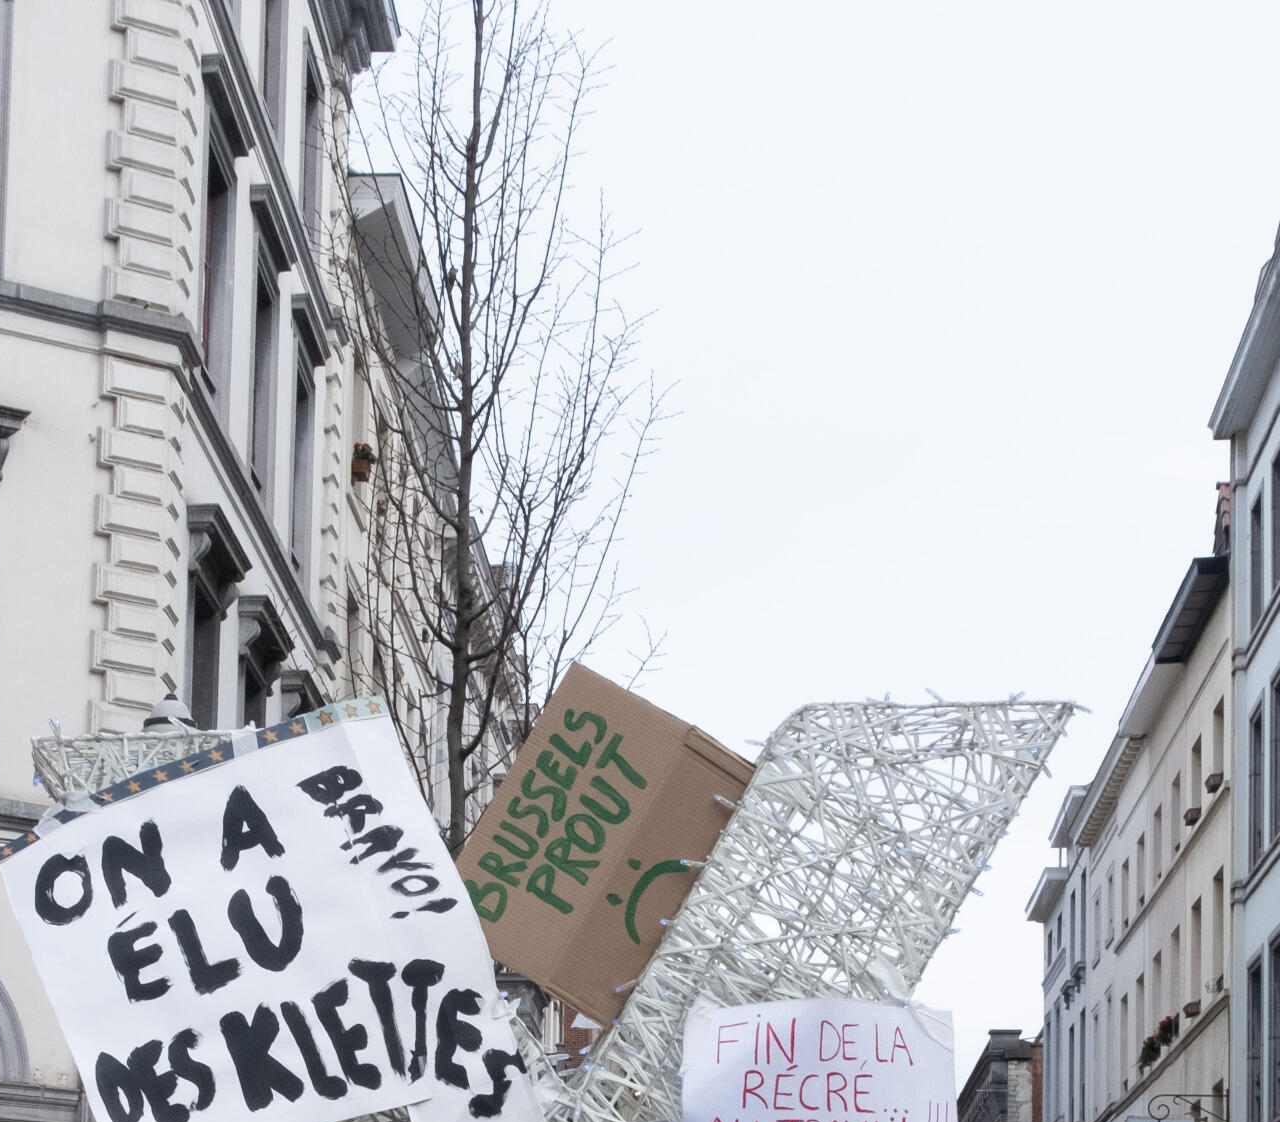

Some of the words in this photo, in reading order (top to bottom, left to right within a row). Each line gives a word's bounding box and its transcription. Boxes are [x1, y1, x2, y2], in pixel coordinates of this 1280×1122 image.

[34, 819, 172, 925] ON
[220, 785, 286, 871] A
[464, 708, 607, 924] BRUSSELS
[526, 733, 648, 915] PROUT
[107, 875, 304, 1005] ÉLU
[820, 1020, 860, 1062] DE
[875, 1023, 913, 1066] LA
